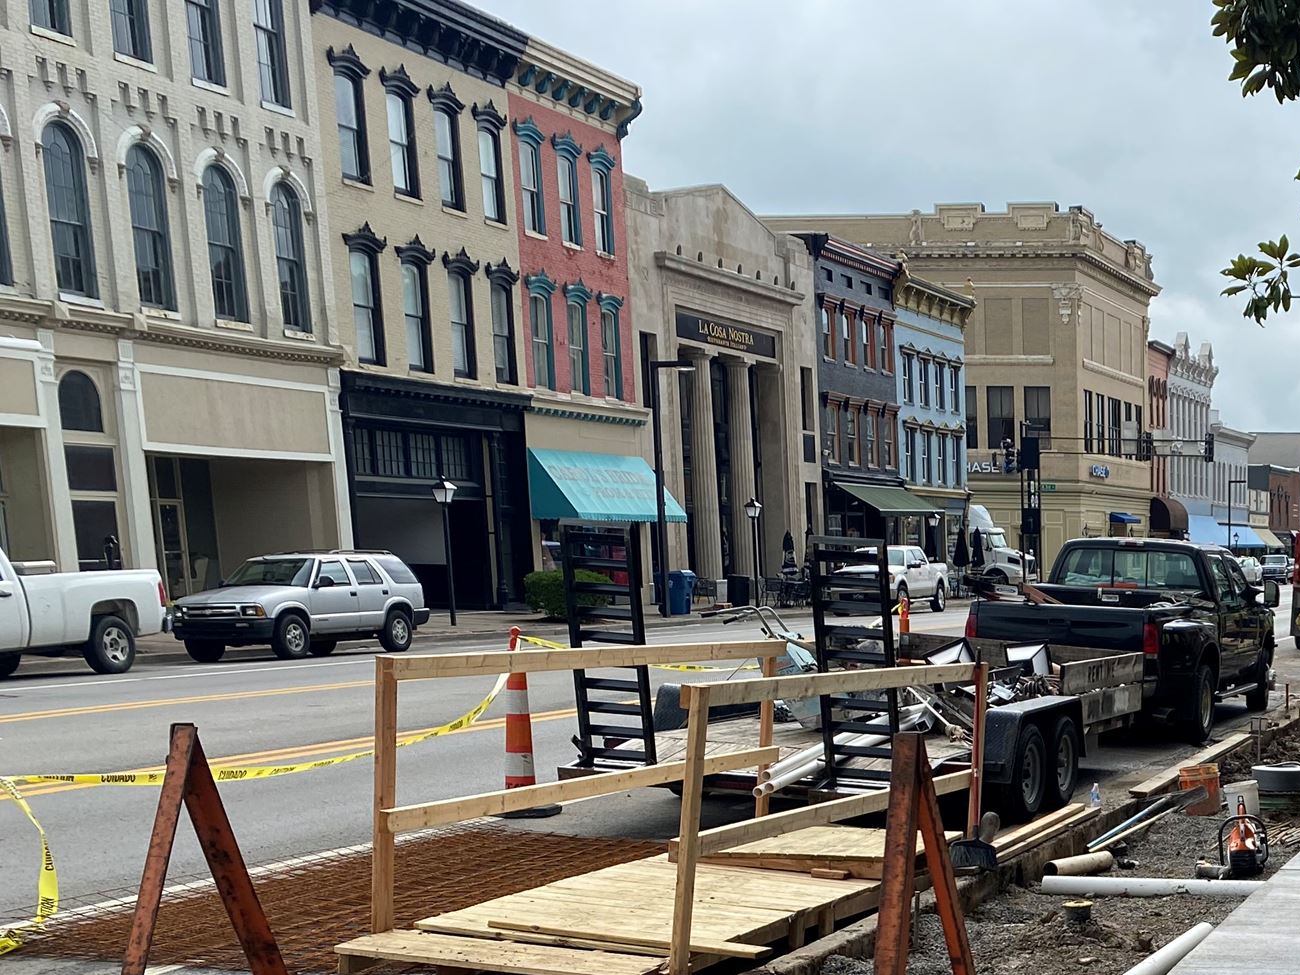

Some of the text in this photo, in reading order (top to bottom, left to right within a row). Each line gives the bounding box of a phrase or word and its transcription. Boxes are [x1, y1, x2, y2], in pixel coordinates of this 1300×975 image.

[698, 319, 754, 345] LA COSA NOSTRA
[966, 462, 1000, 473] HASE
[217, 769, 248, 781] CUIDADO
